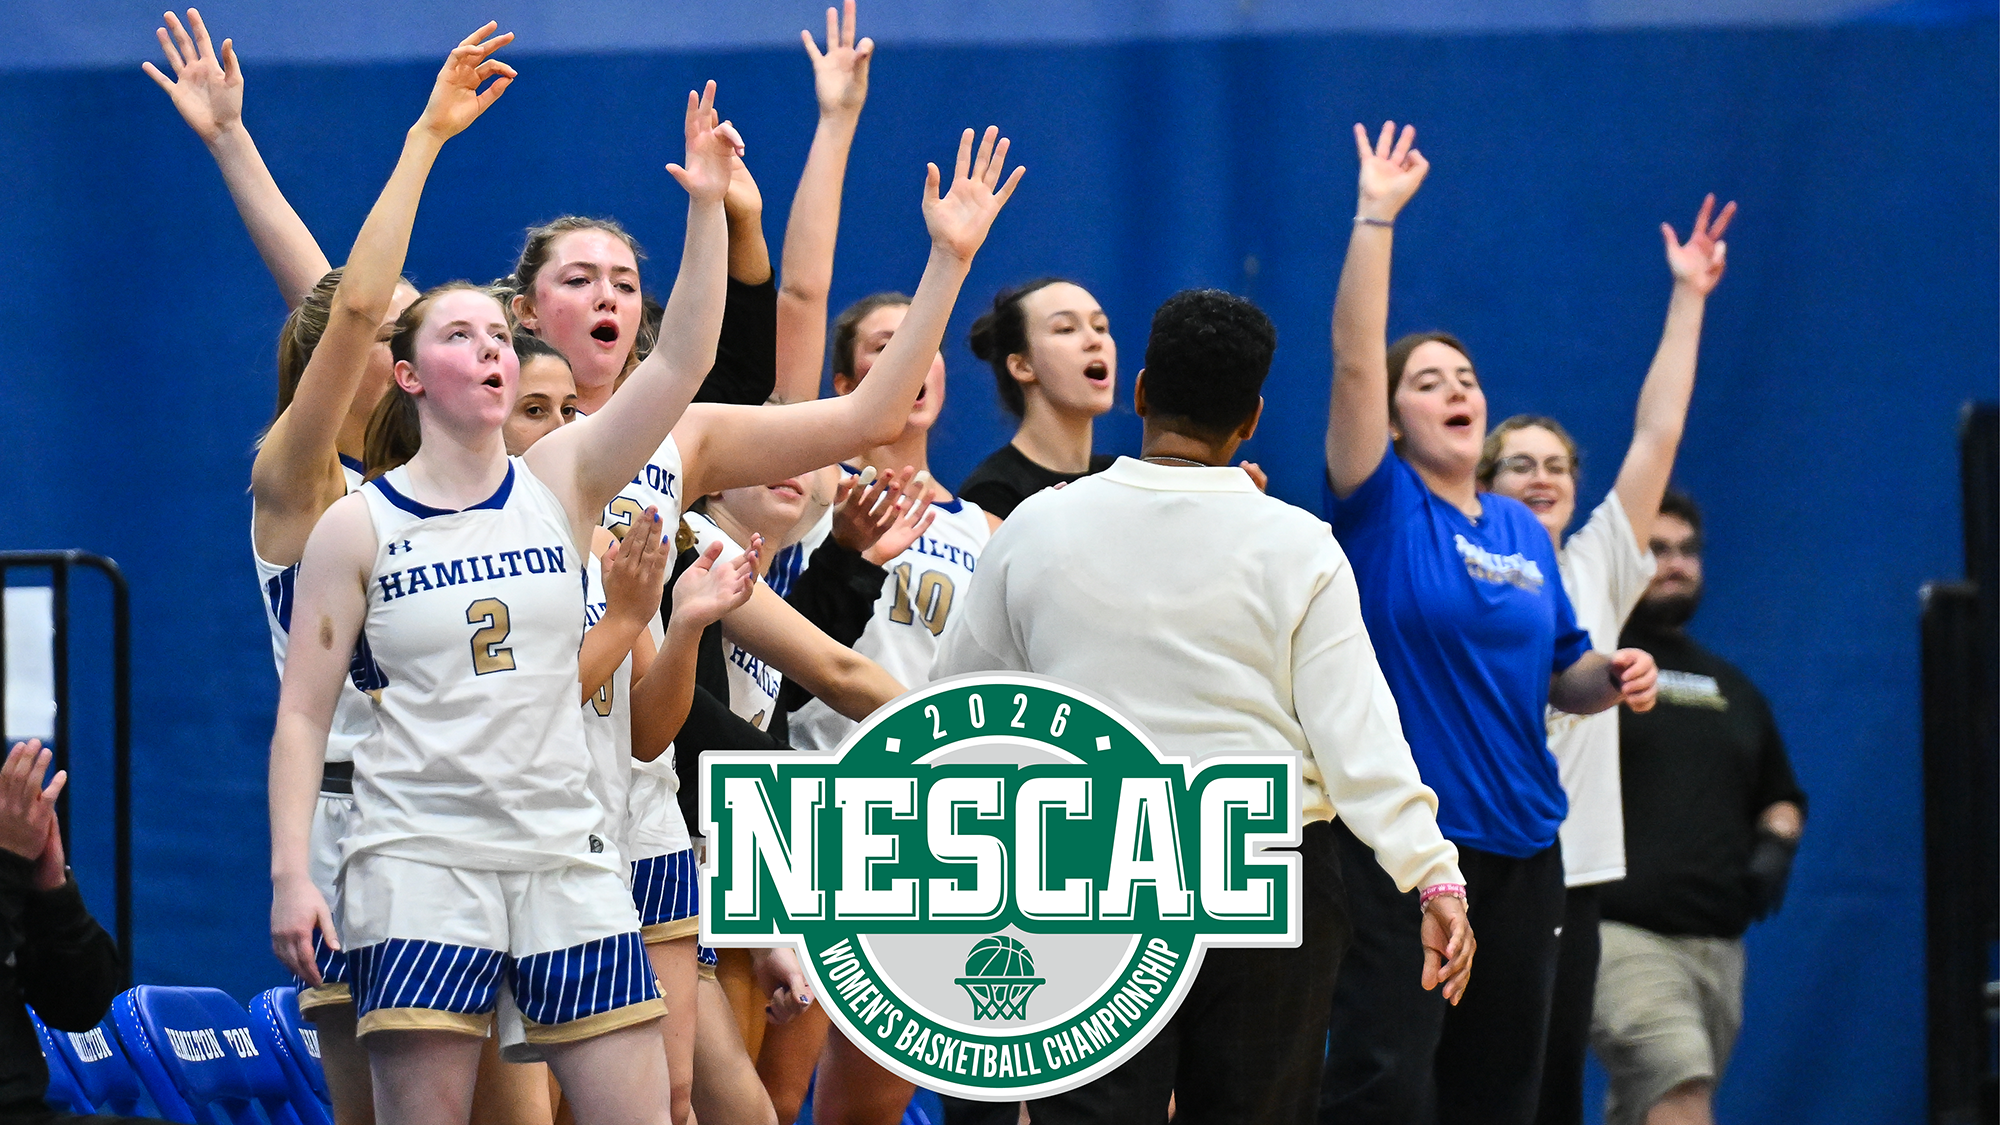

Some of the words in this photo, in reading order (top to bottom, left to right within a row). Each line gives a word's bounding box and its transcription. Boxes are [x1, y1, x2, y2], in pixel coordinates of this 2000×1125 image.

[378, 546, 566, 602] HAMILTON
[907, 534, 976, 574] ILTO
[889, 561, 956, 637] 10
[465, 597, 516, 676] 2
